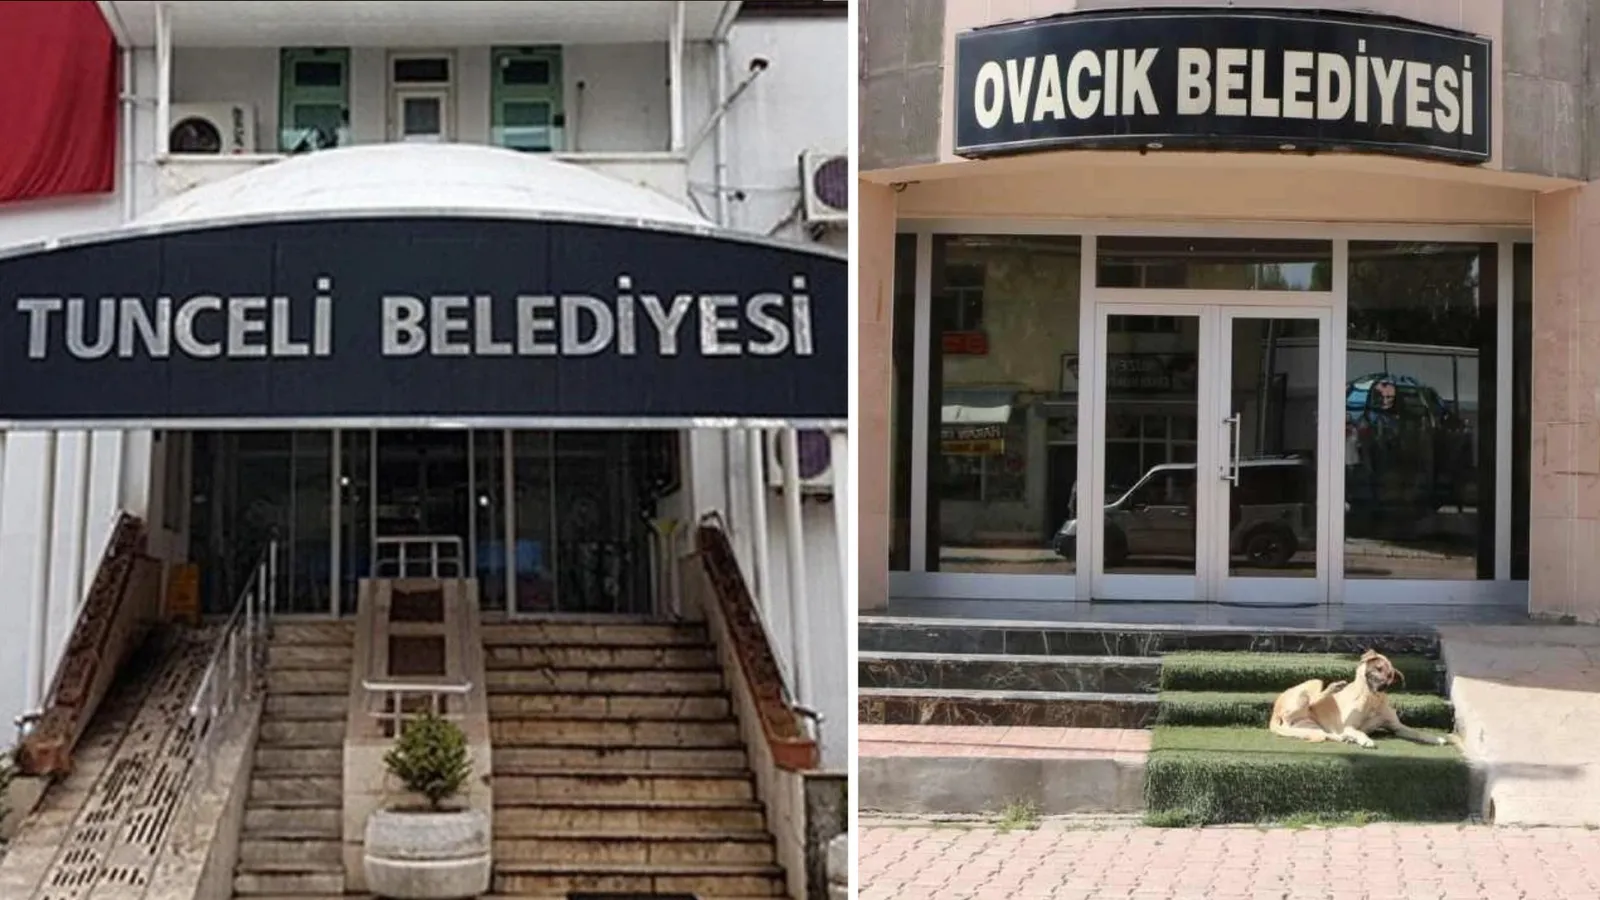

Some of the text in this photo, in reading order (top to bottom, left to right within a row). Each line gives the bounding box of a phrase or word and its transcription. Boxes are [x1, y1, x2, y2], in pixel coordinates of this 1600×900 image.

[973, 39, 1473, 136] OVACIK BELEDİYESİ
[17, 275, 813, 359] TUNCELİ BELEDİYESİ
